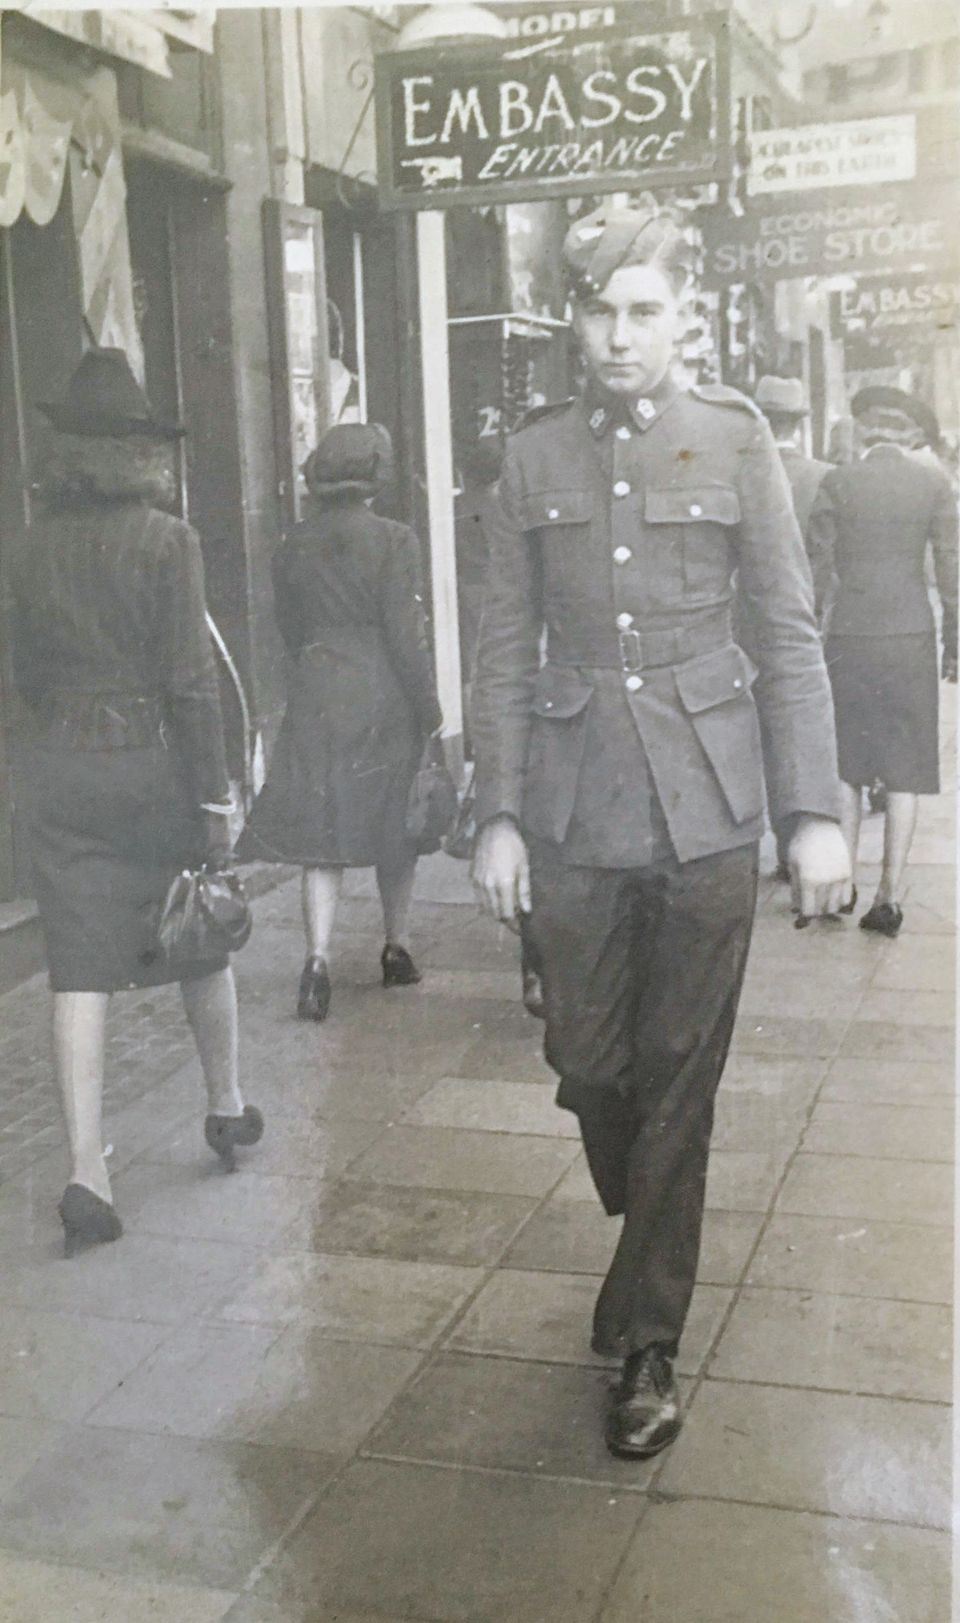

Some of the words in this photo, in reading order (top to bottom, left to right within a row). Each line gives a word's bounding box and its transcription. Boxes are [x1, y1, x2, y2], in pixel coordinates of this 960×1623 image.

[402, 58, 708, 147] EMBASSY
[477, 130, 686, 180] ENTRANCE
[713, 235, 809, 274] SHOE
[823, 220, 944, 262] STORE
